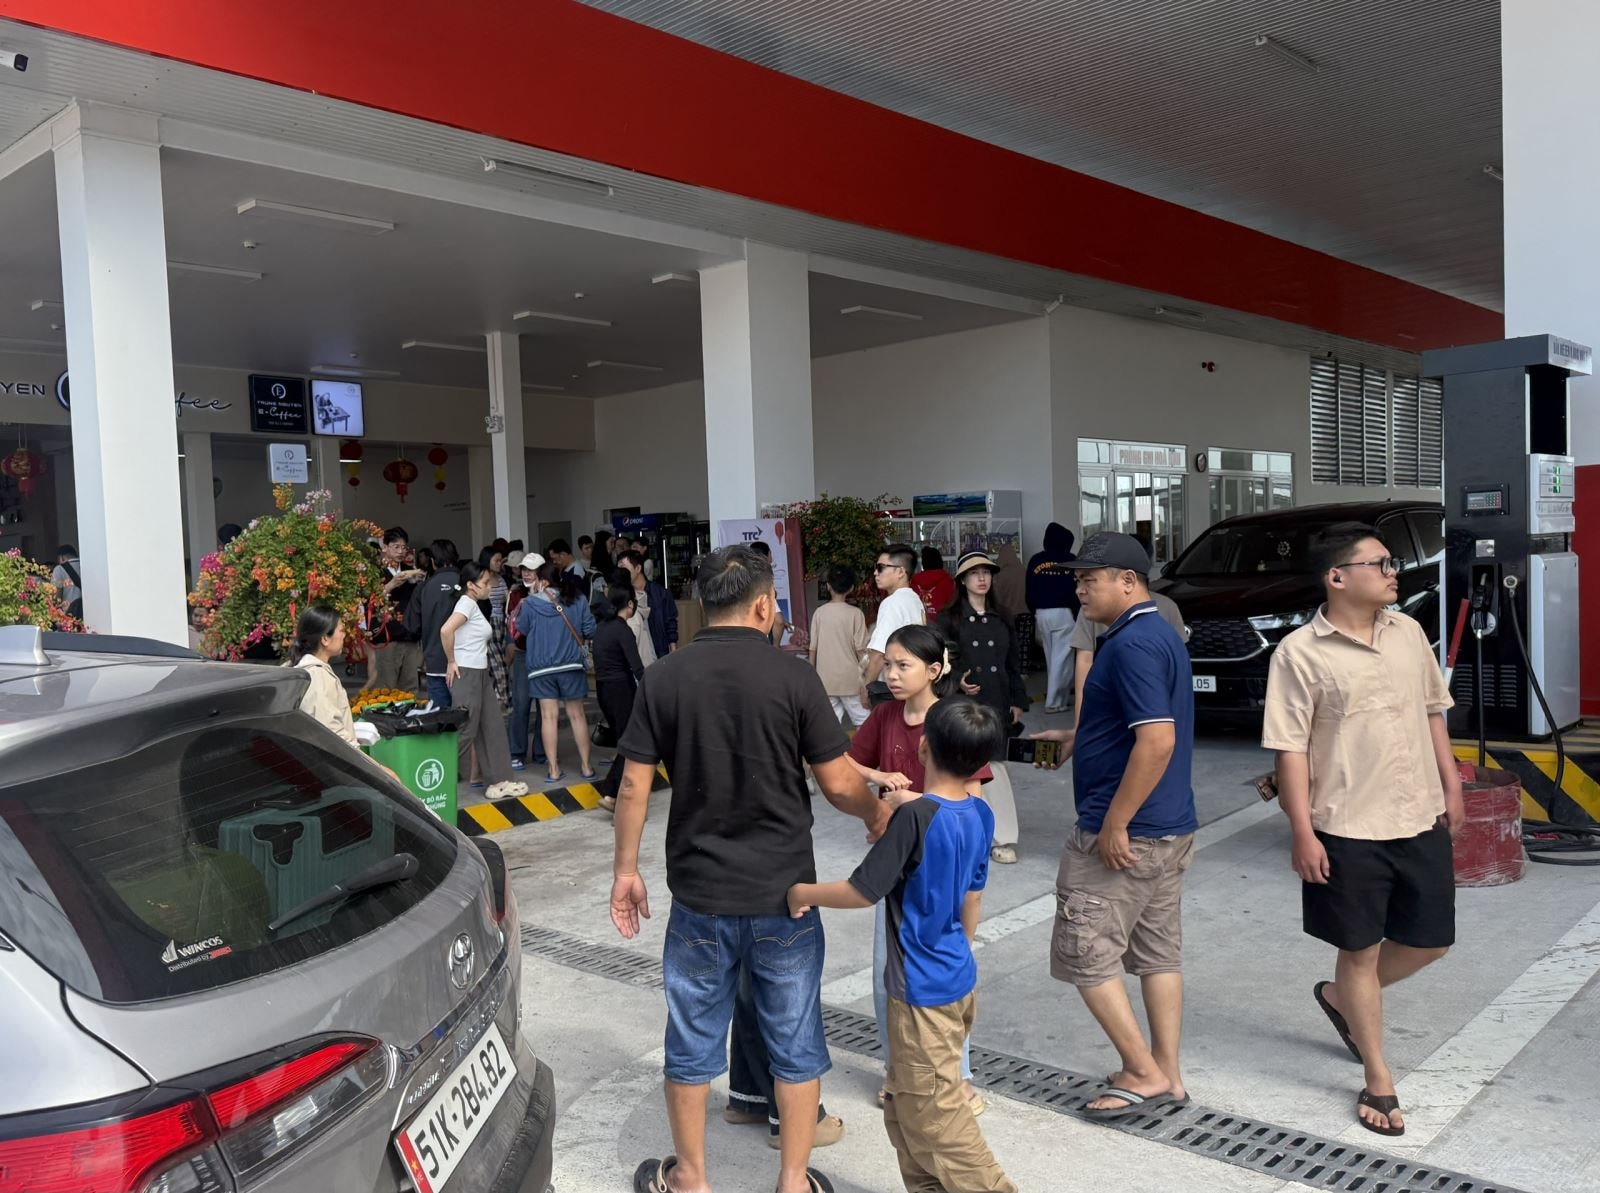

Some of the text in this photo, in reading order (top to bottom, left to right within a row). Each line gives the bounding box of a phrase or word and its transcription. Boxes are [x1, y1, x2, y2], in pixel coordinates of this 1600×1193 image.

[0, 381, 45, 395] YEN
[175, 391, 232, 417] fee
[742, 531, 760, 541] TTC
[1194, 678, 1210, 689] .05
[177, 936, 223, 957] WINCOS
